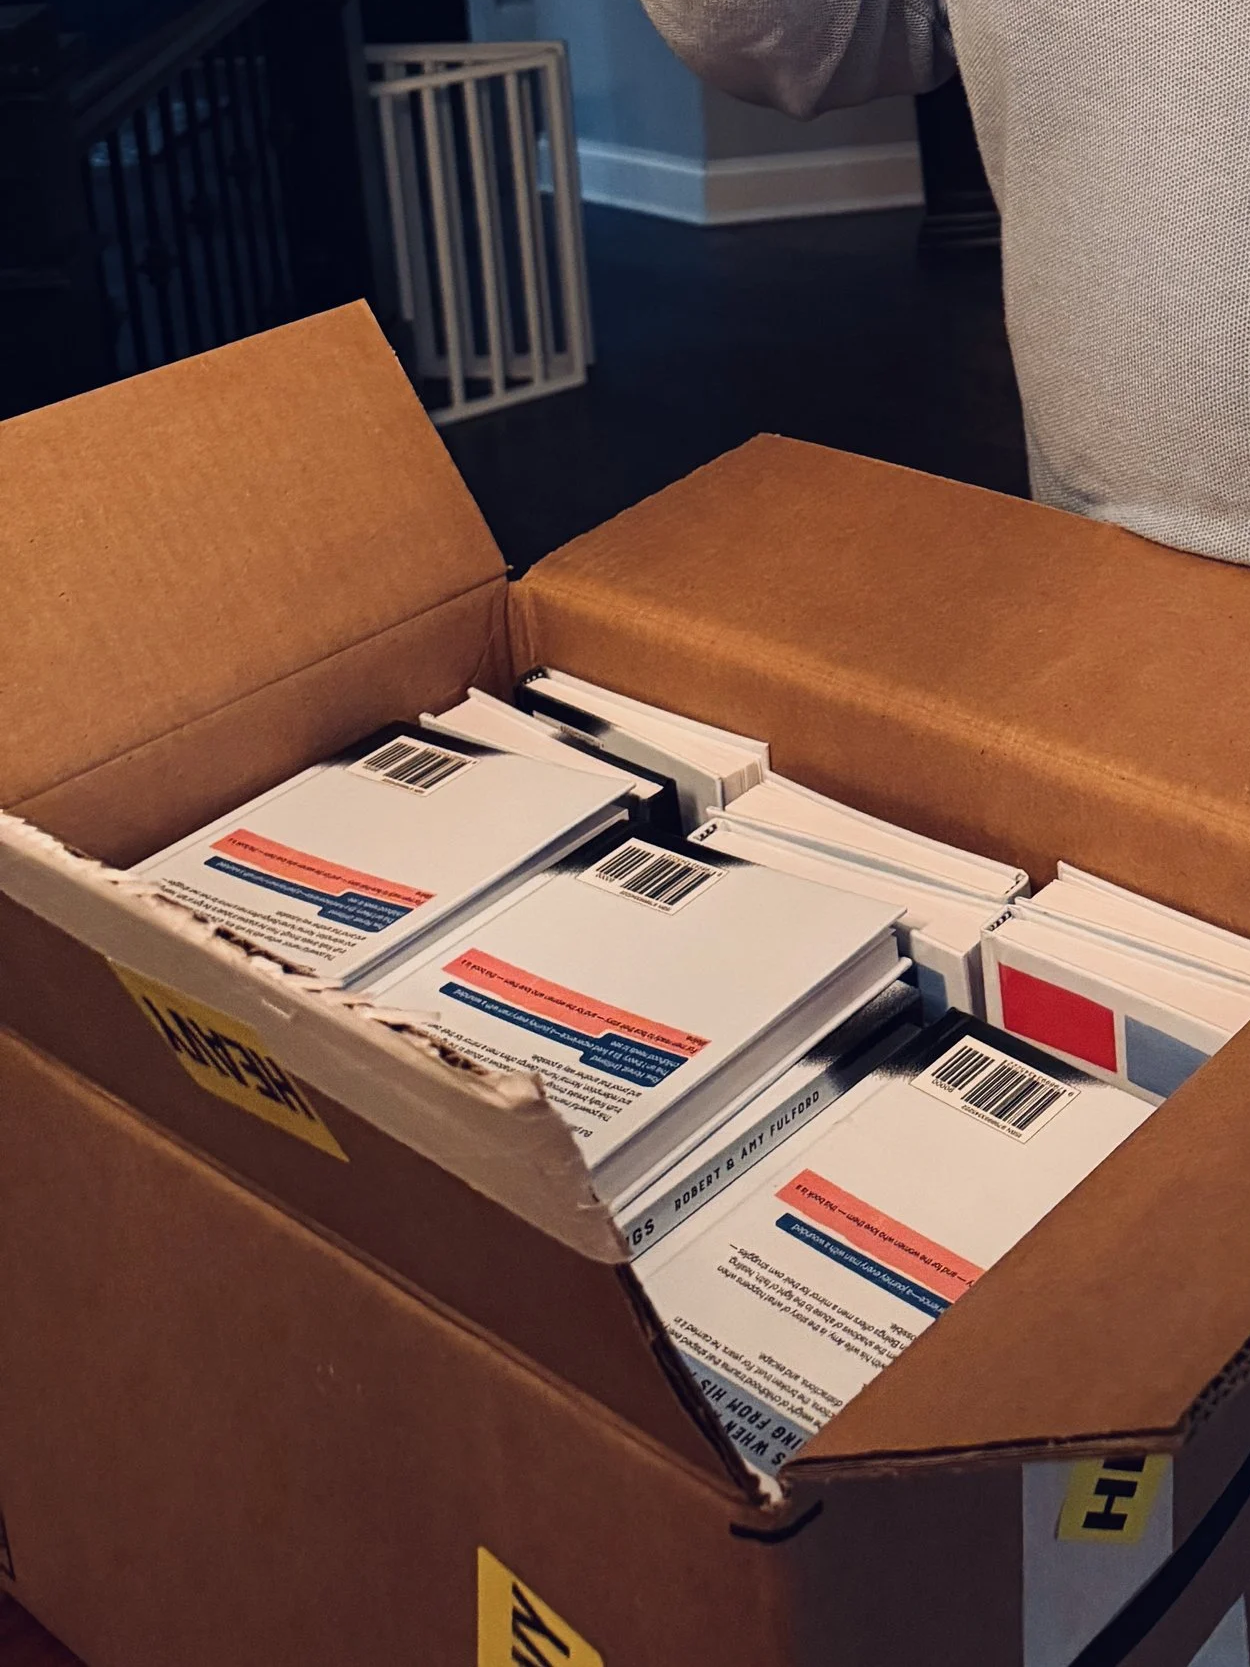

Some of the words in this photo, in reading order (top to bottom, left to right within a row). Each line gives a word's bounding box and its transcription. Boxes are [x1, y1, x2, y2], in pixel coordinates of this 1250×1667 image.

[674, 1167, 721, 1212] ROBERT
[726, 1158, 735, 1170] &
[741, 1133, 765, 1160] AMY
[770, 1090, 820, 1137] FULFORD
[737, 1248, 769, 1269] struggles
[716, 1265, 737, 1279] when
[767, 1267, 784, 1278] own
[735, 1276, 766, 1299] happens
[782, 1276, 800, 1289] their
[798, 1285, 810, 1295] for
[763, 1294, 783, 1307] what
[808, 1291, 832, 1307] mirror
[789, 1308, 809, 1323] story
[836, 1307, 854, 1320] men
[807, 1320, 820, 1331] the
[852, 1316, 874, 1331] offers
[819, 1327, 827, 1335] is
[873, 1328, 900, 1348] Beings
[843, 1342, 860, 1354] wife
[859, 1351, 872, 1362] his
[700, 1379, 727, 1402] HIS
[726, 1398, 772, 1430] FROM
[724, 1420, 770, 1456] WHEN
